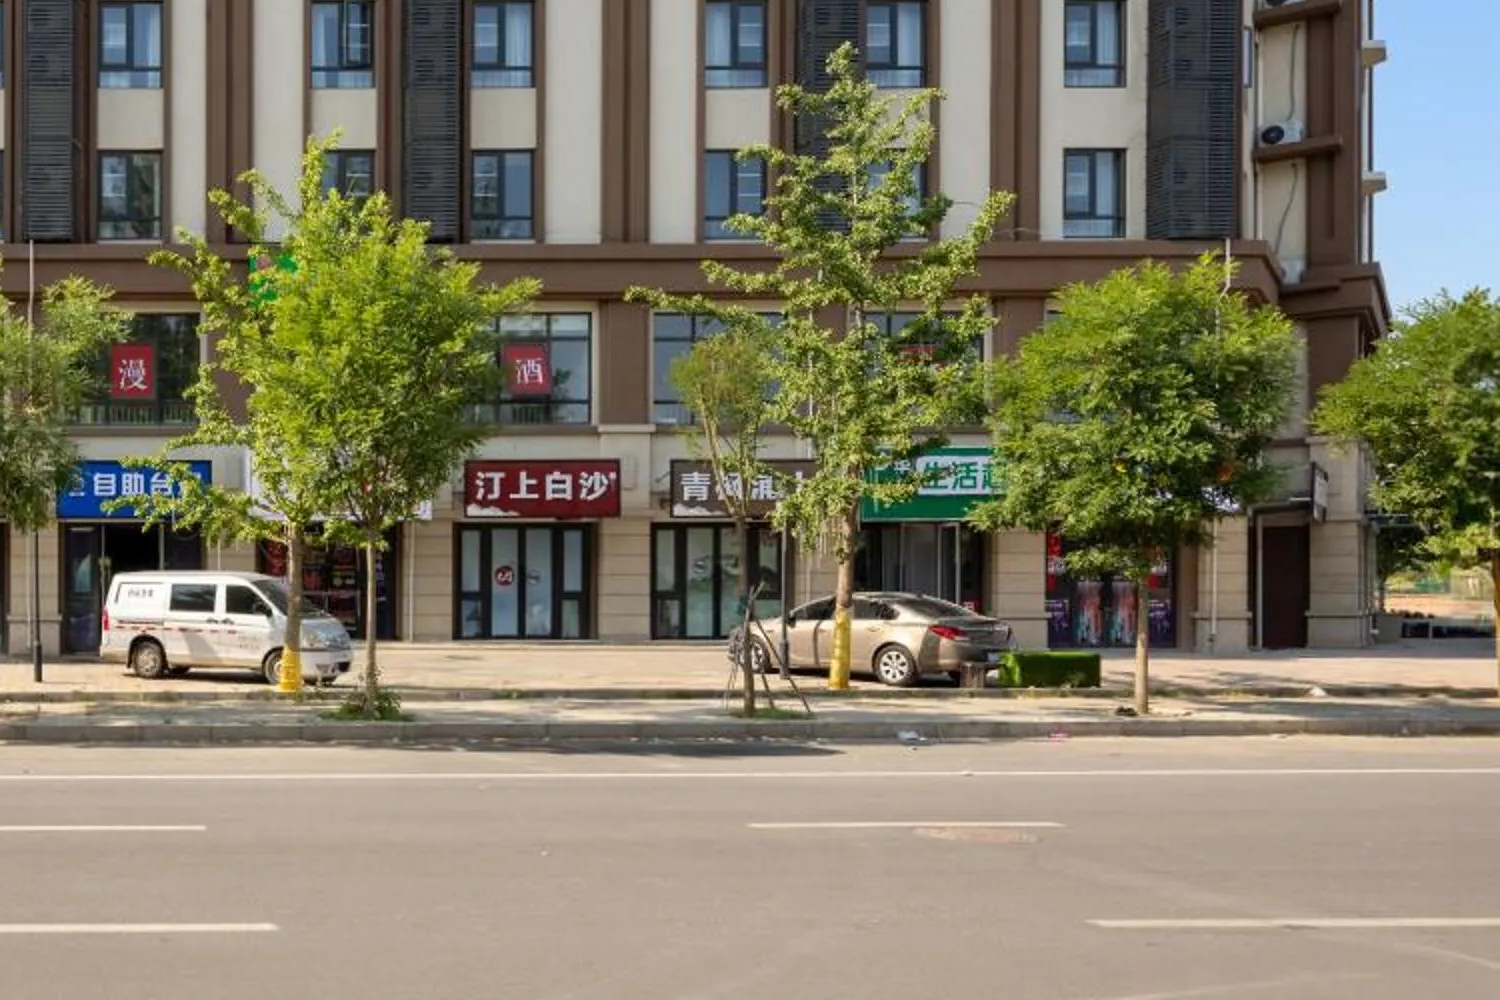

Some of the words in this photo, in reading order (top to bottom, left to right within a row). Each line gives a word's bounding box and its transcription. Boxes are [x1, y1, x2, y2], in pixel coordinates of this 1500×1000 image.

[118, 359, 148, 391] 漫
[93, 472, 203, 497] 自助台
[475, 471, 610, 501] 汀上白沙
